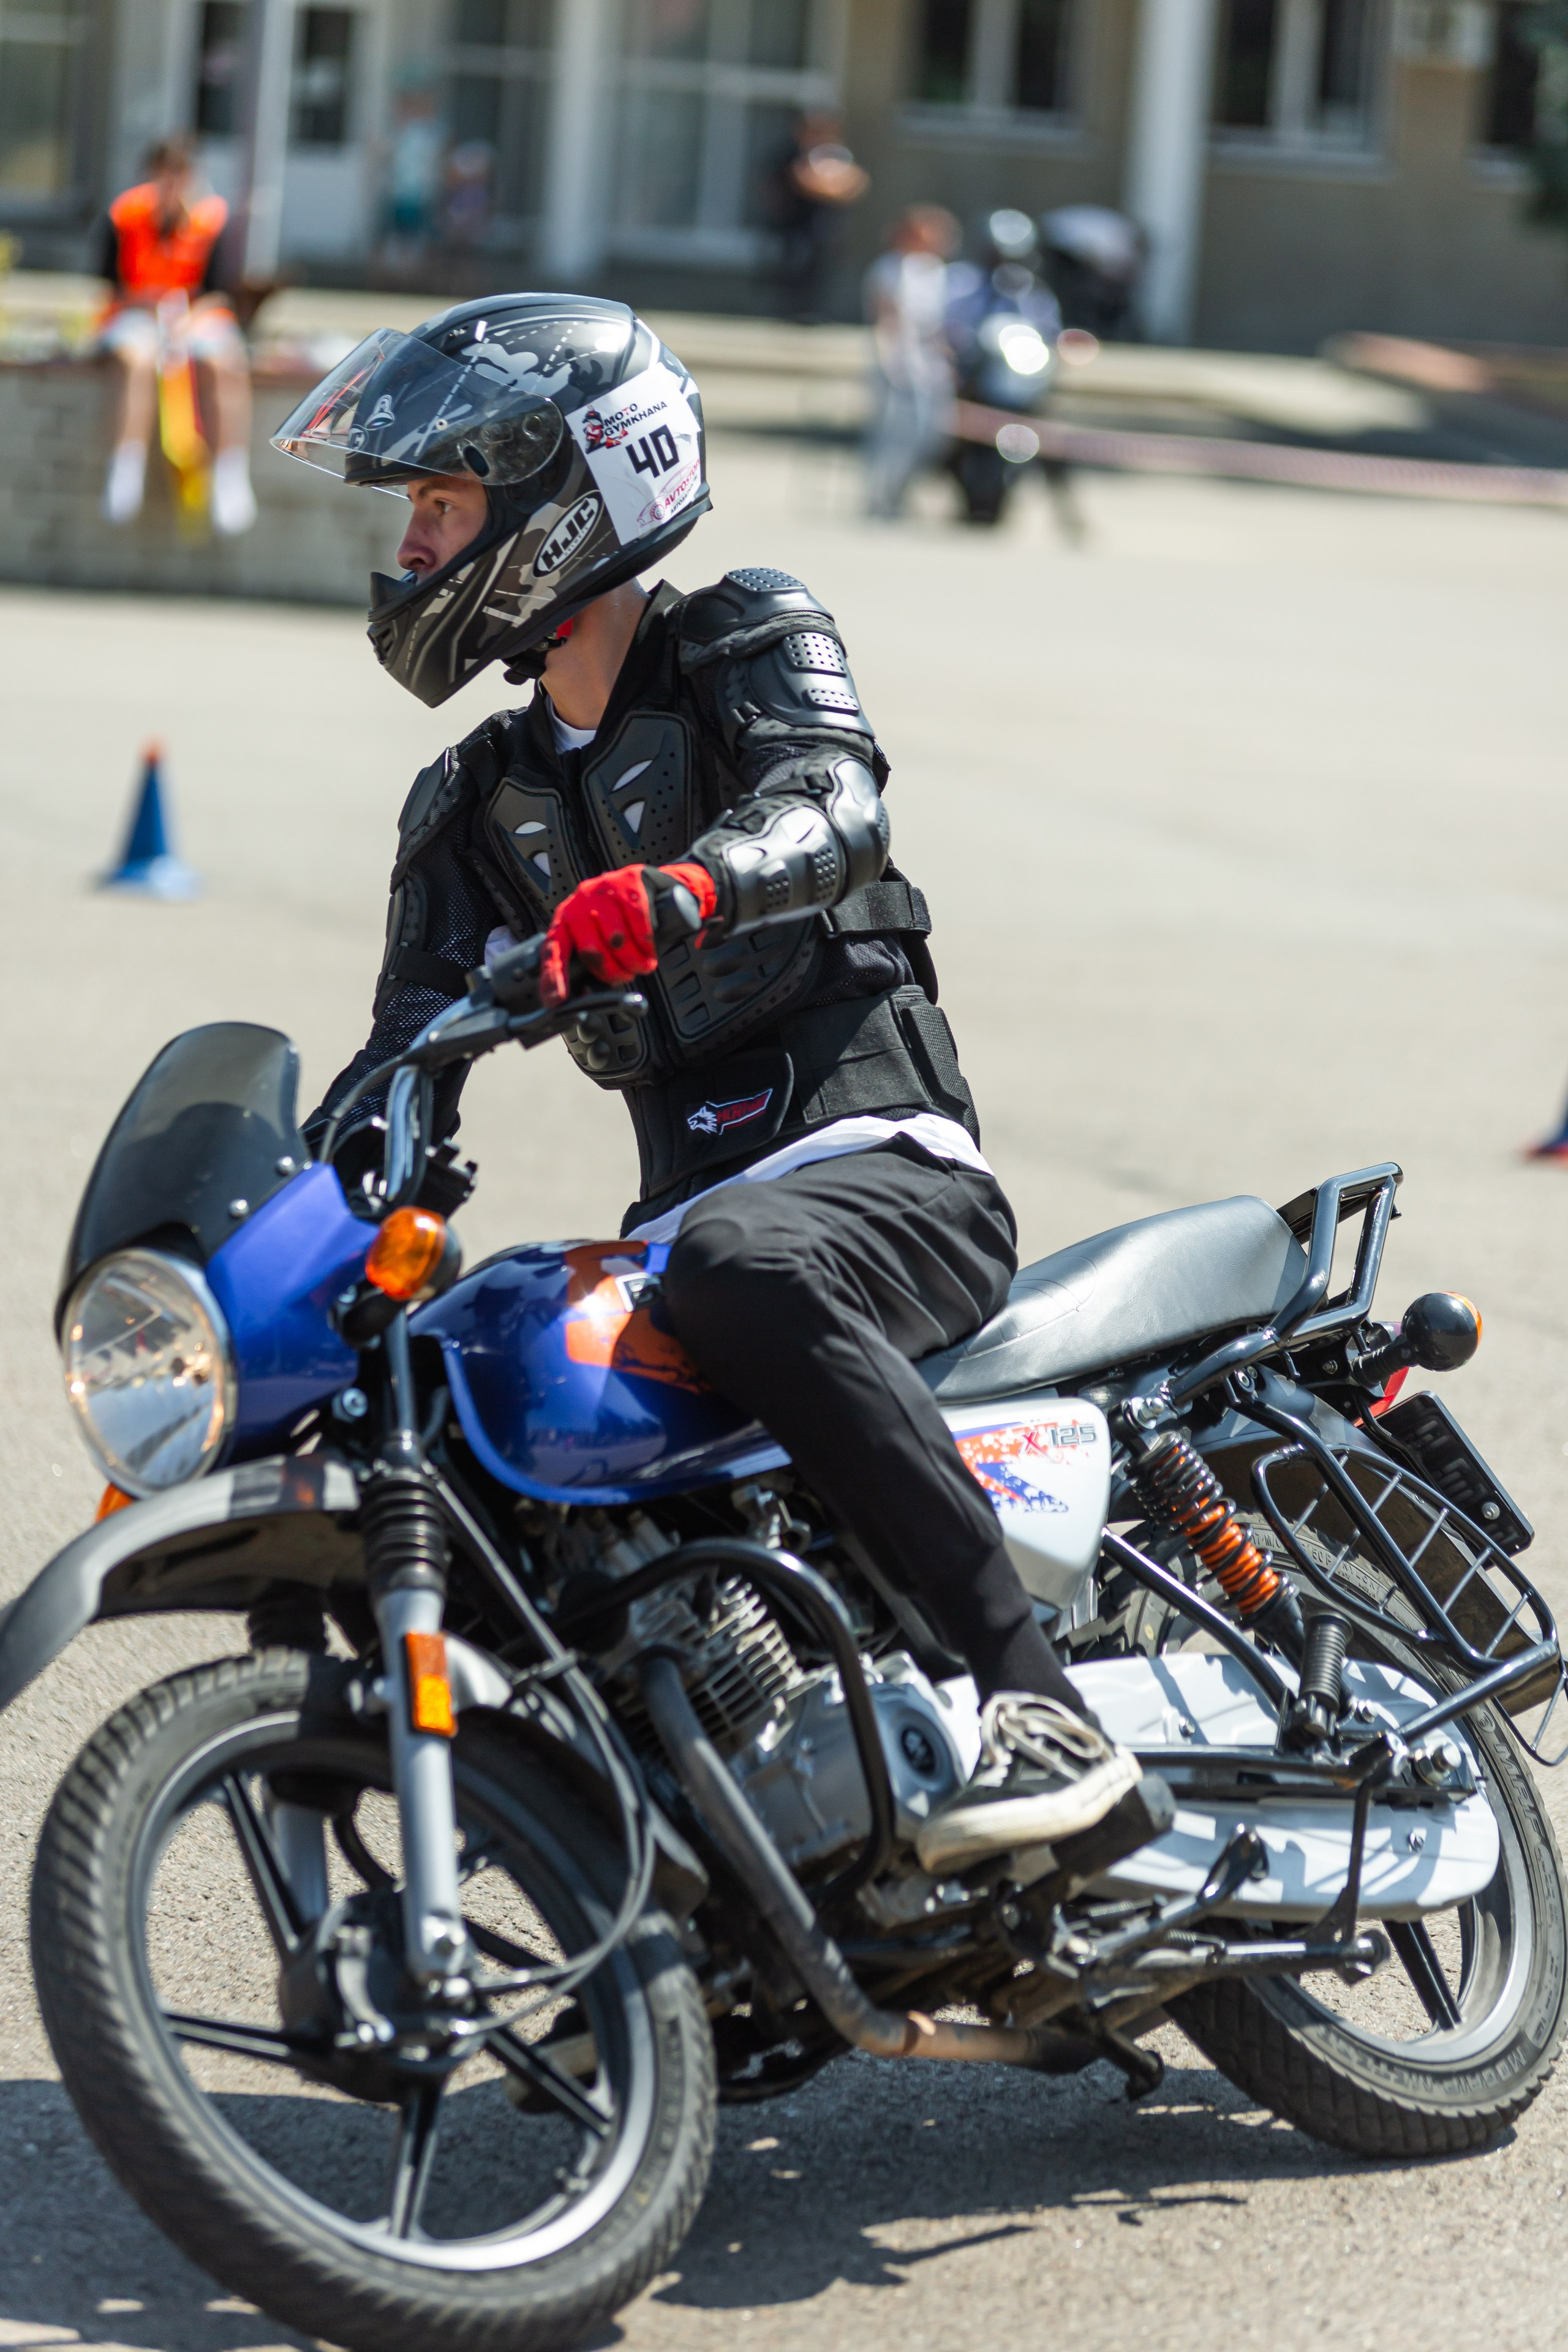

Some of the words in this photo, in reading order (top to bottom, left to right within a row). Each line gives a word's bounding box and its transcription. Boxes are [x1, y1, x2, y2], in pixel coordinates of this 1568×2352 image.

[603, 403, 638, 427] MOTO
[604, 401, 668, 436] GYMKHANA
[625, 424, 680, 478] 40
[540, 499, 595, 570] HJC
[1493, 1743, 1545, 1839] MRF
